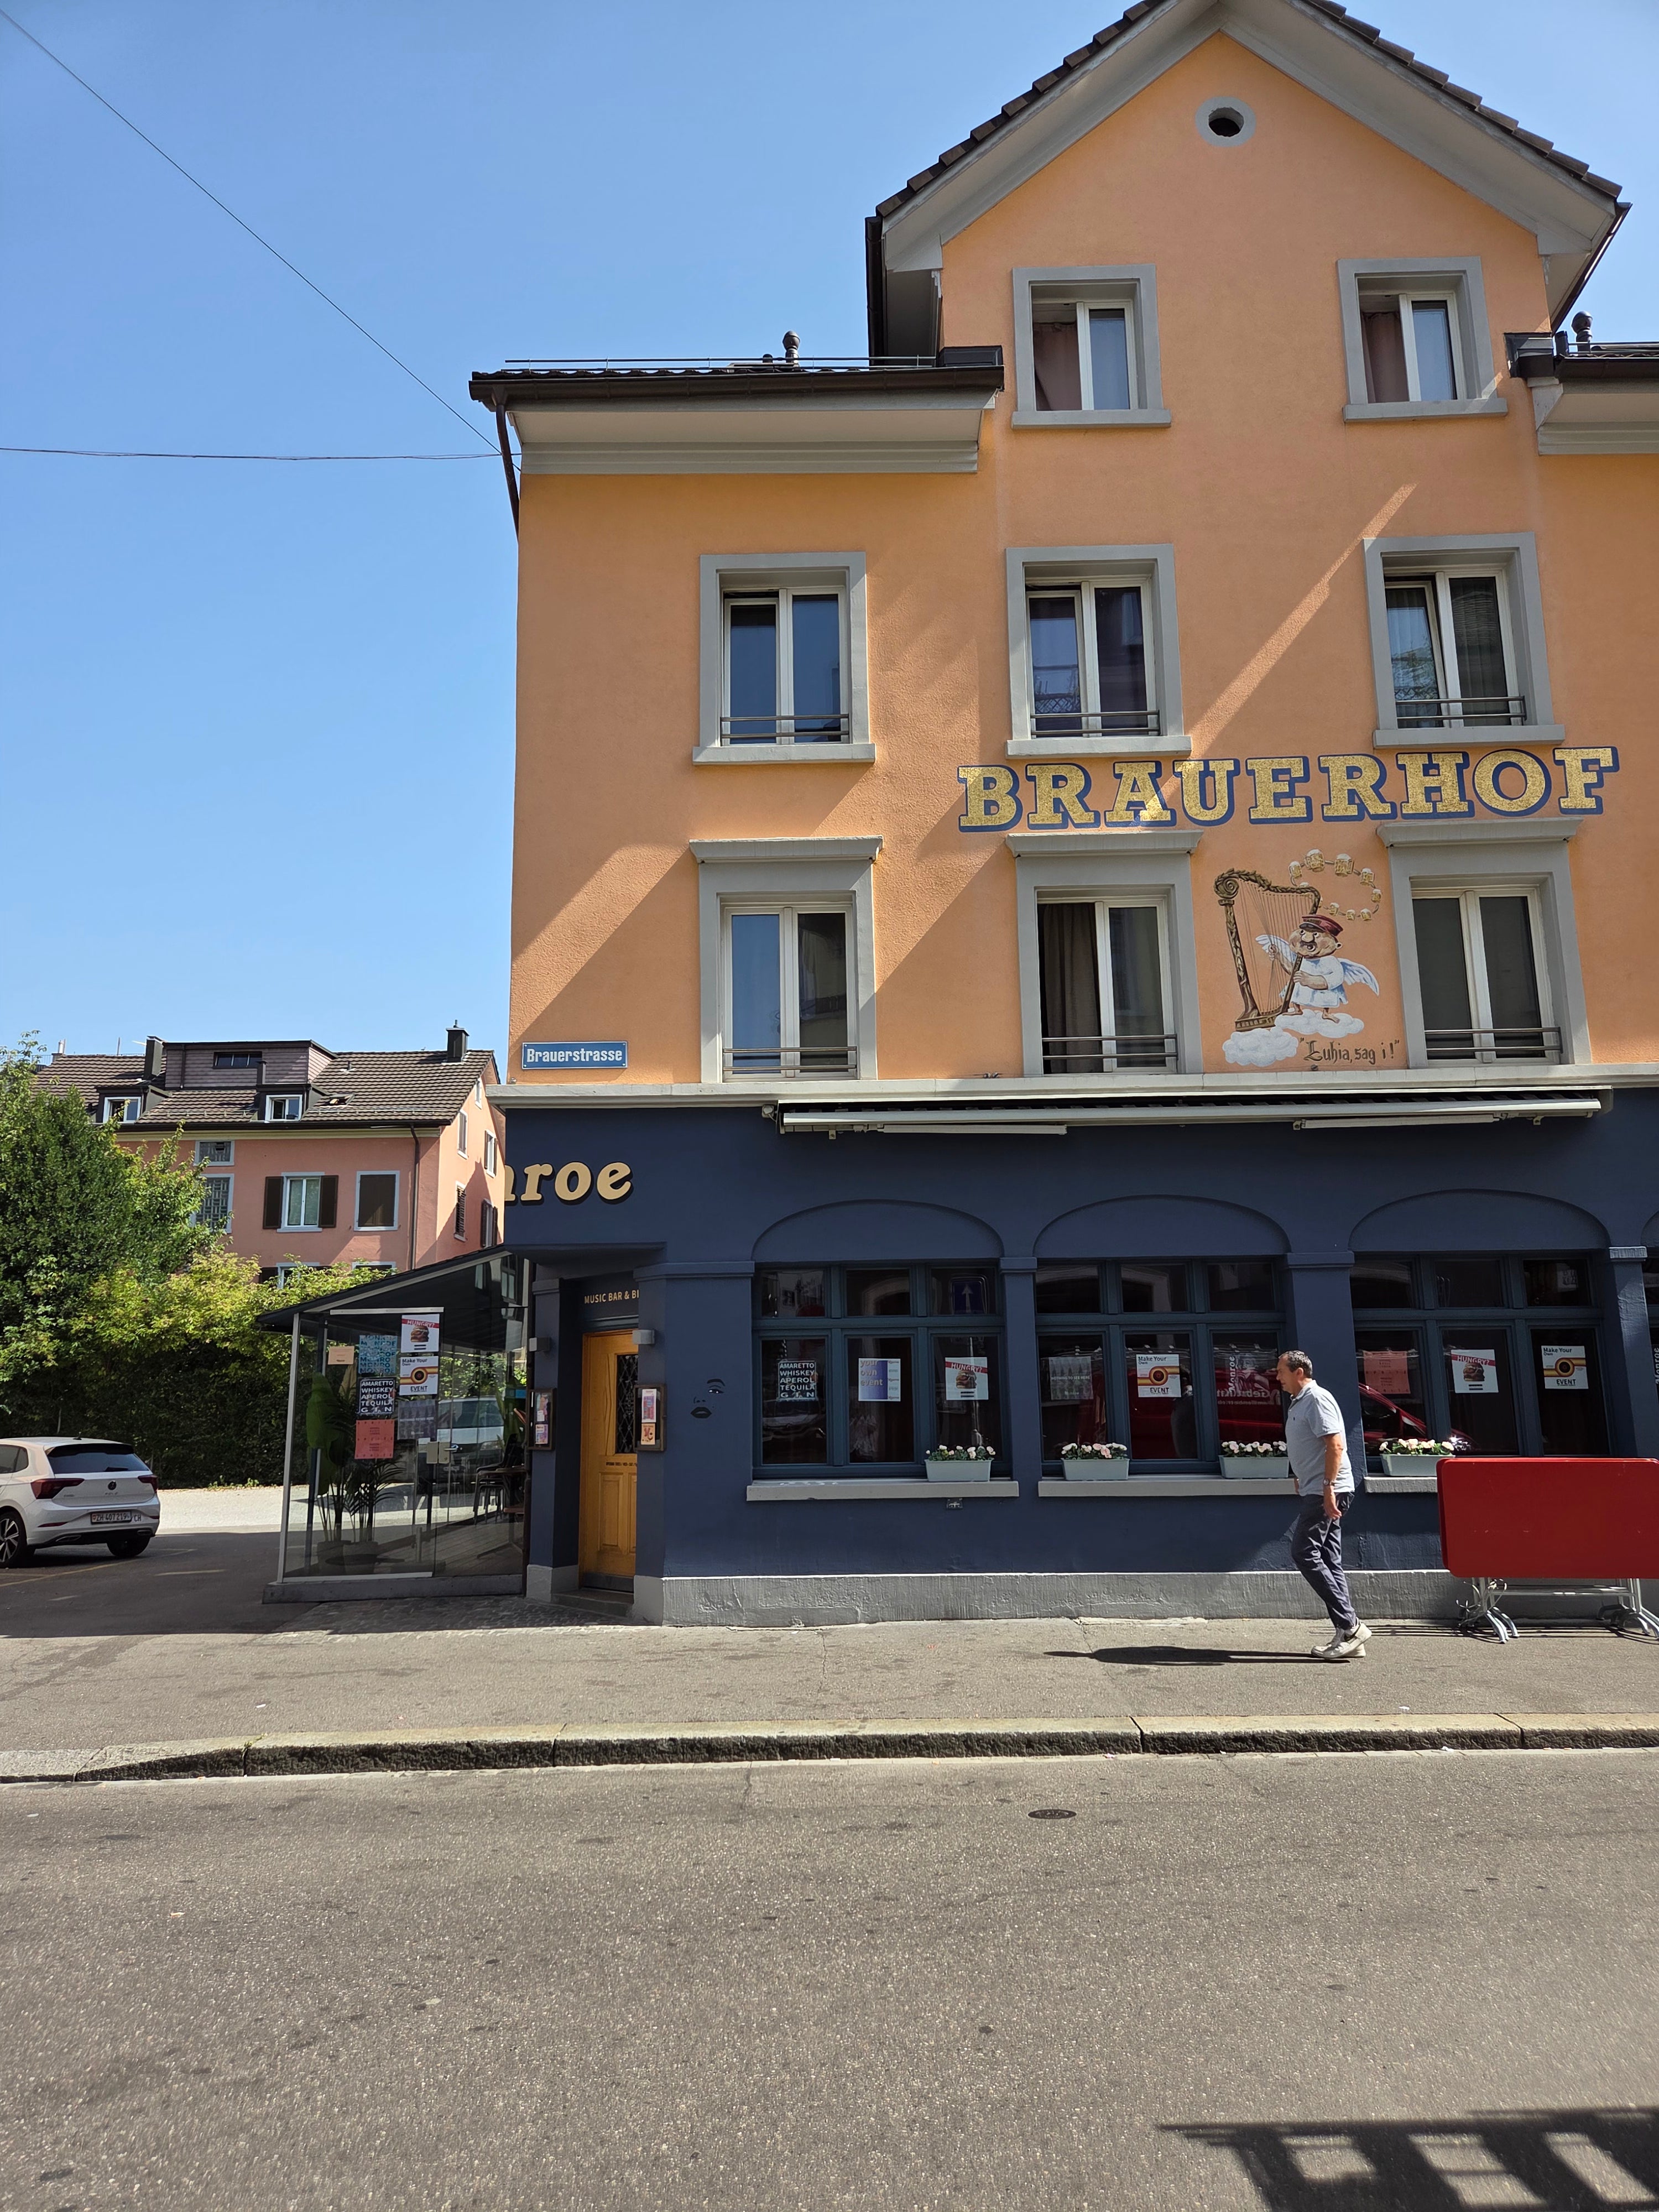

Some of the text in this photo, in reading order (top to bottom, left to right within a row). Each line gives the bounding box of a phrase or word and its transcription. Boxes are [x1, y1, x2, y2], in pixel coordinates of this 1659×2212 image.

[957, 747, 1619, 831] BRAUERHOF
[526, 1048, 623, 1062] Brauerstrasse
[1354, 1048, 1376, 1065] sag
[504, 1162, 632, 1203] roe
[584, 1293, 607, 1305] MUSIC
[608, 1292, 623, 1302] BAR
[624, 1291, 630, 1300] &
[407, 1320, 435, 1328] HUNGRY?
[1457, 1355, 1490, 1366] HUNGRY?
[951, 1363, 983, 1373] HUNGRY?
